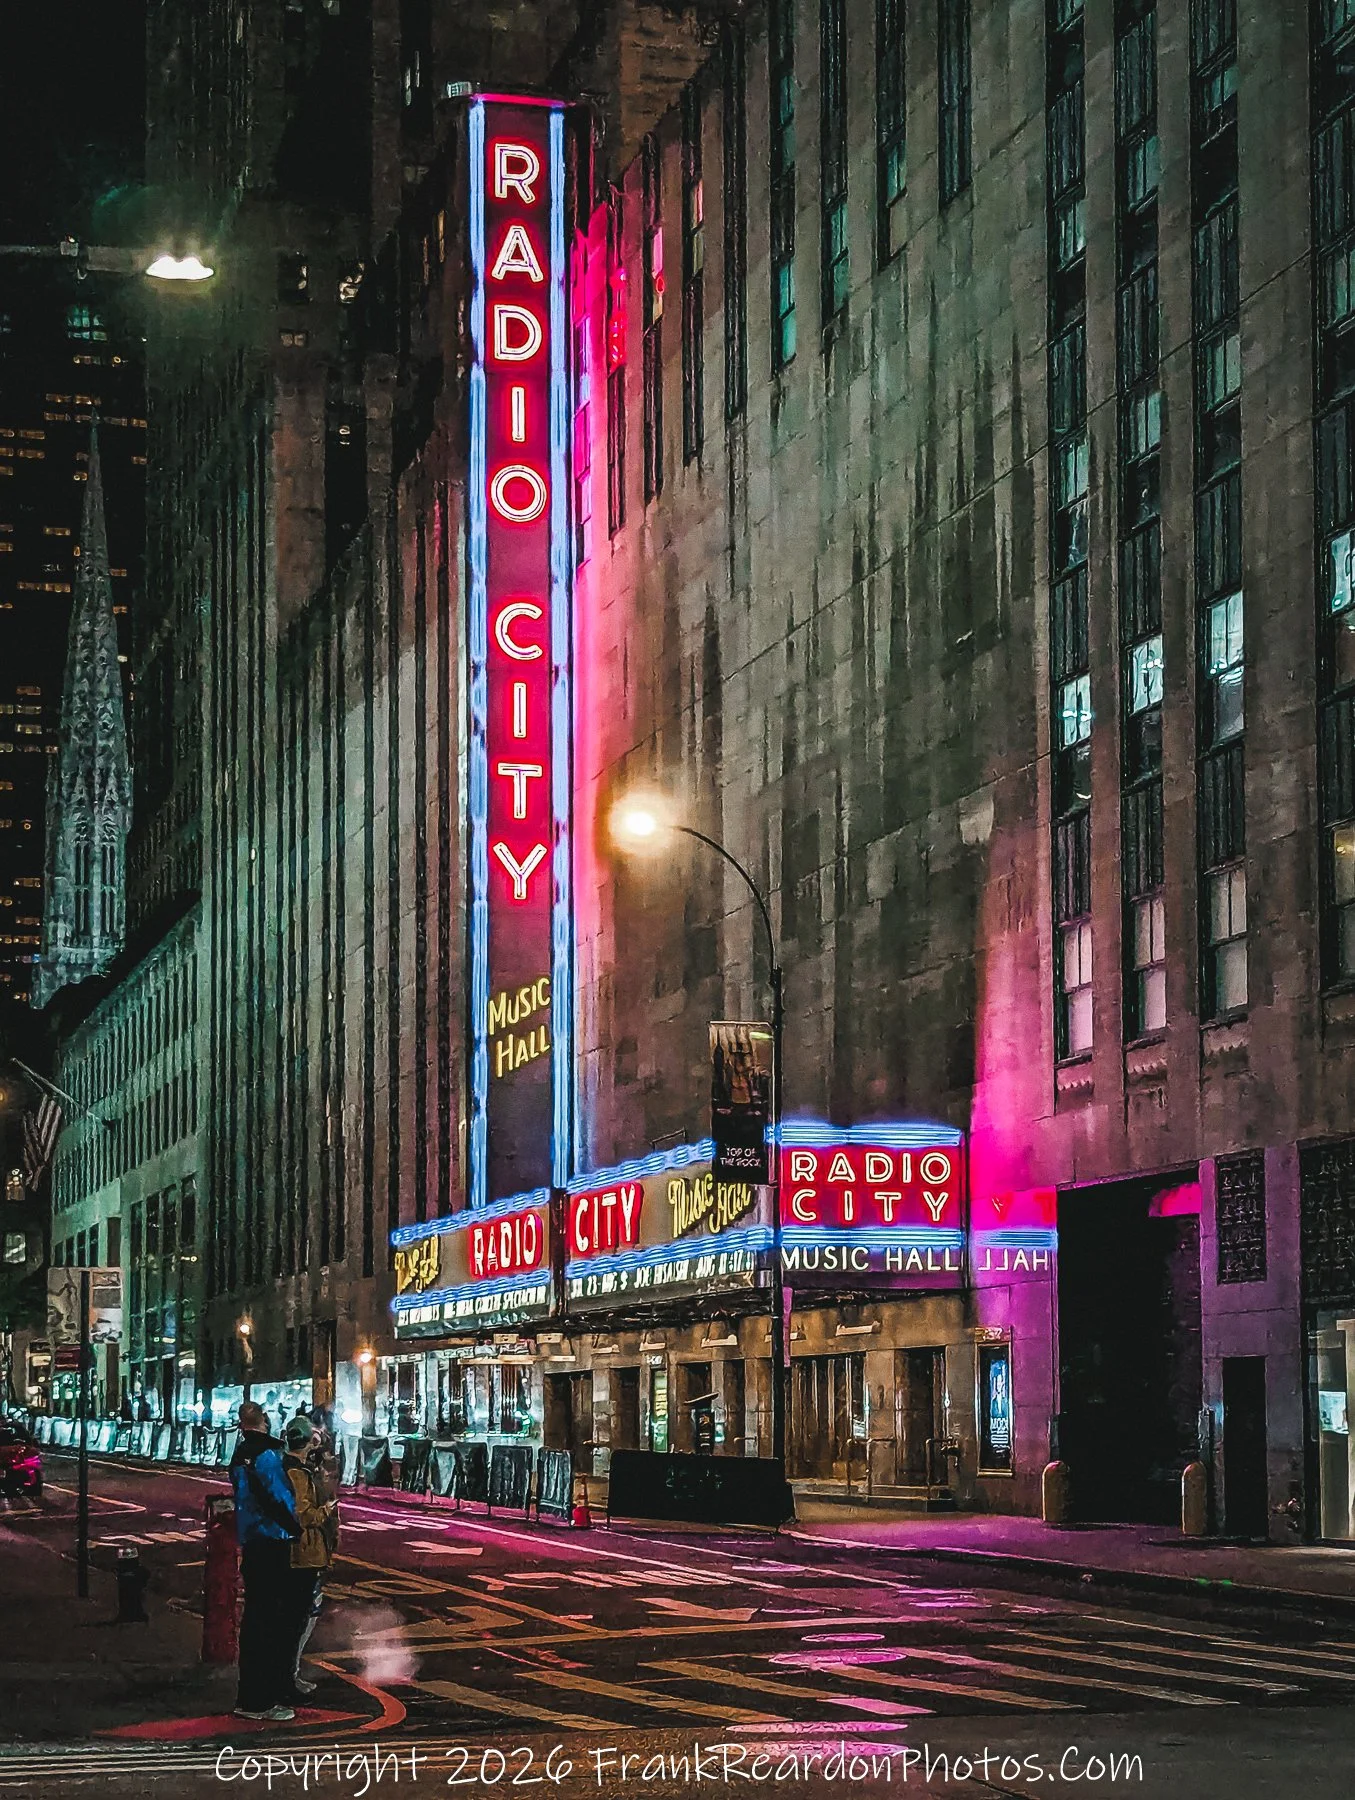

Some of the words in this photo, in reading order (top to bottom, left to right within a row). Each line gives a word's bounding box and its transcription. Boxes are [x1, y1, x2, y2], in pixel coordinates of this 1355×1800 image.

[491, 143, 547, 522] RADIO
[493, 602, 548, 899] CITY
[489, 977, 551, 1035] MUSIC
[497, 1025, 551, 1077] HALL
[791, 1151, 951, 1184] RADIO
[575, 1184, 636, 1252] CITY
[792, 1188, 949, 1222] CITY
[473, 1213, 537, 1276] RADIO
[781, 1246, 869, 1271] MUSIC
[885, 1247, 959, 1271] HALL
